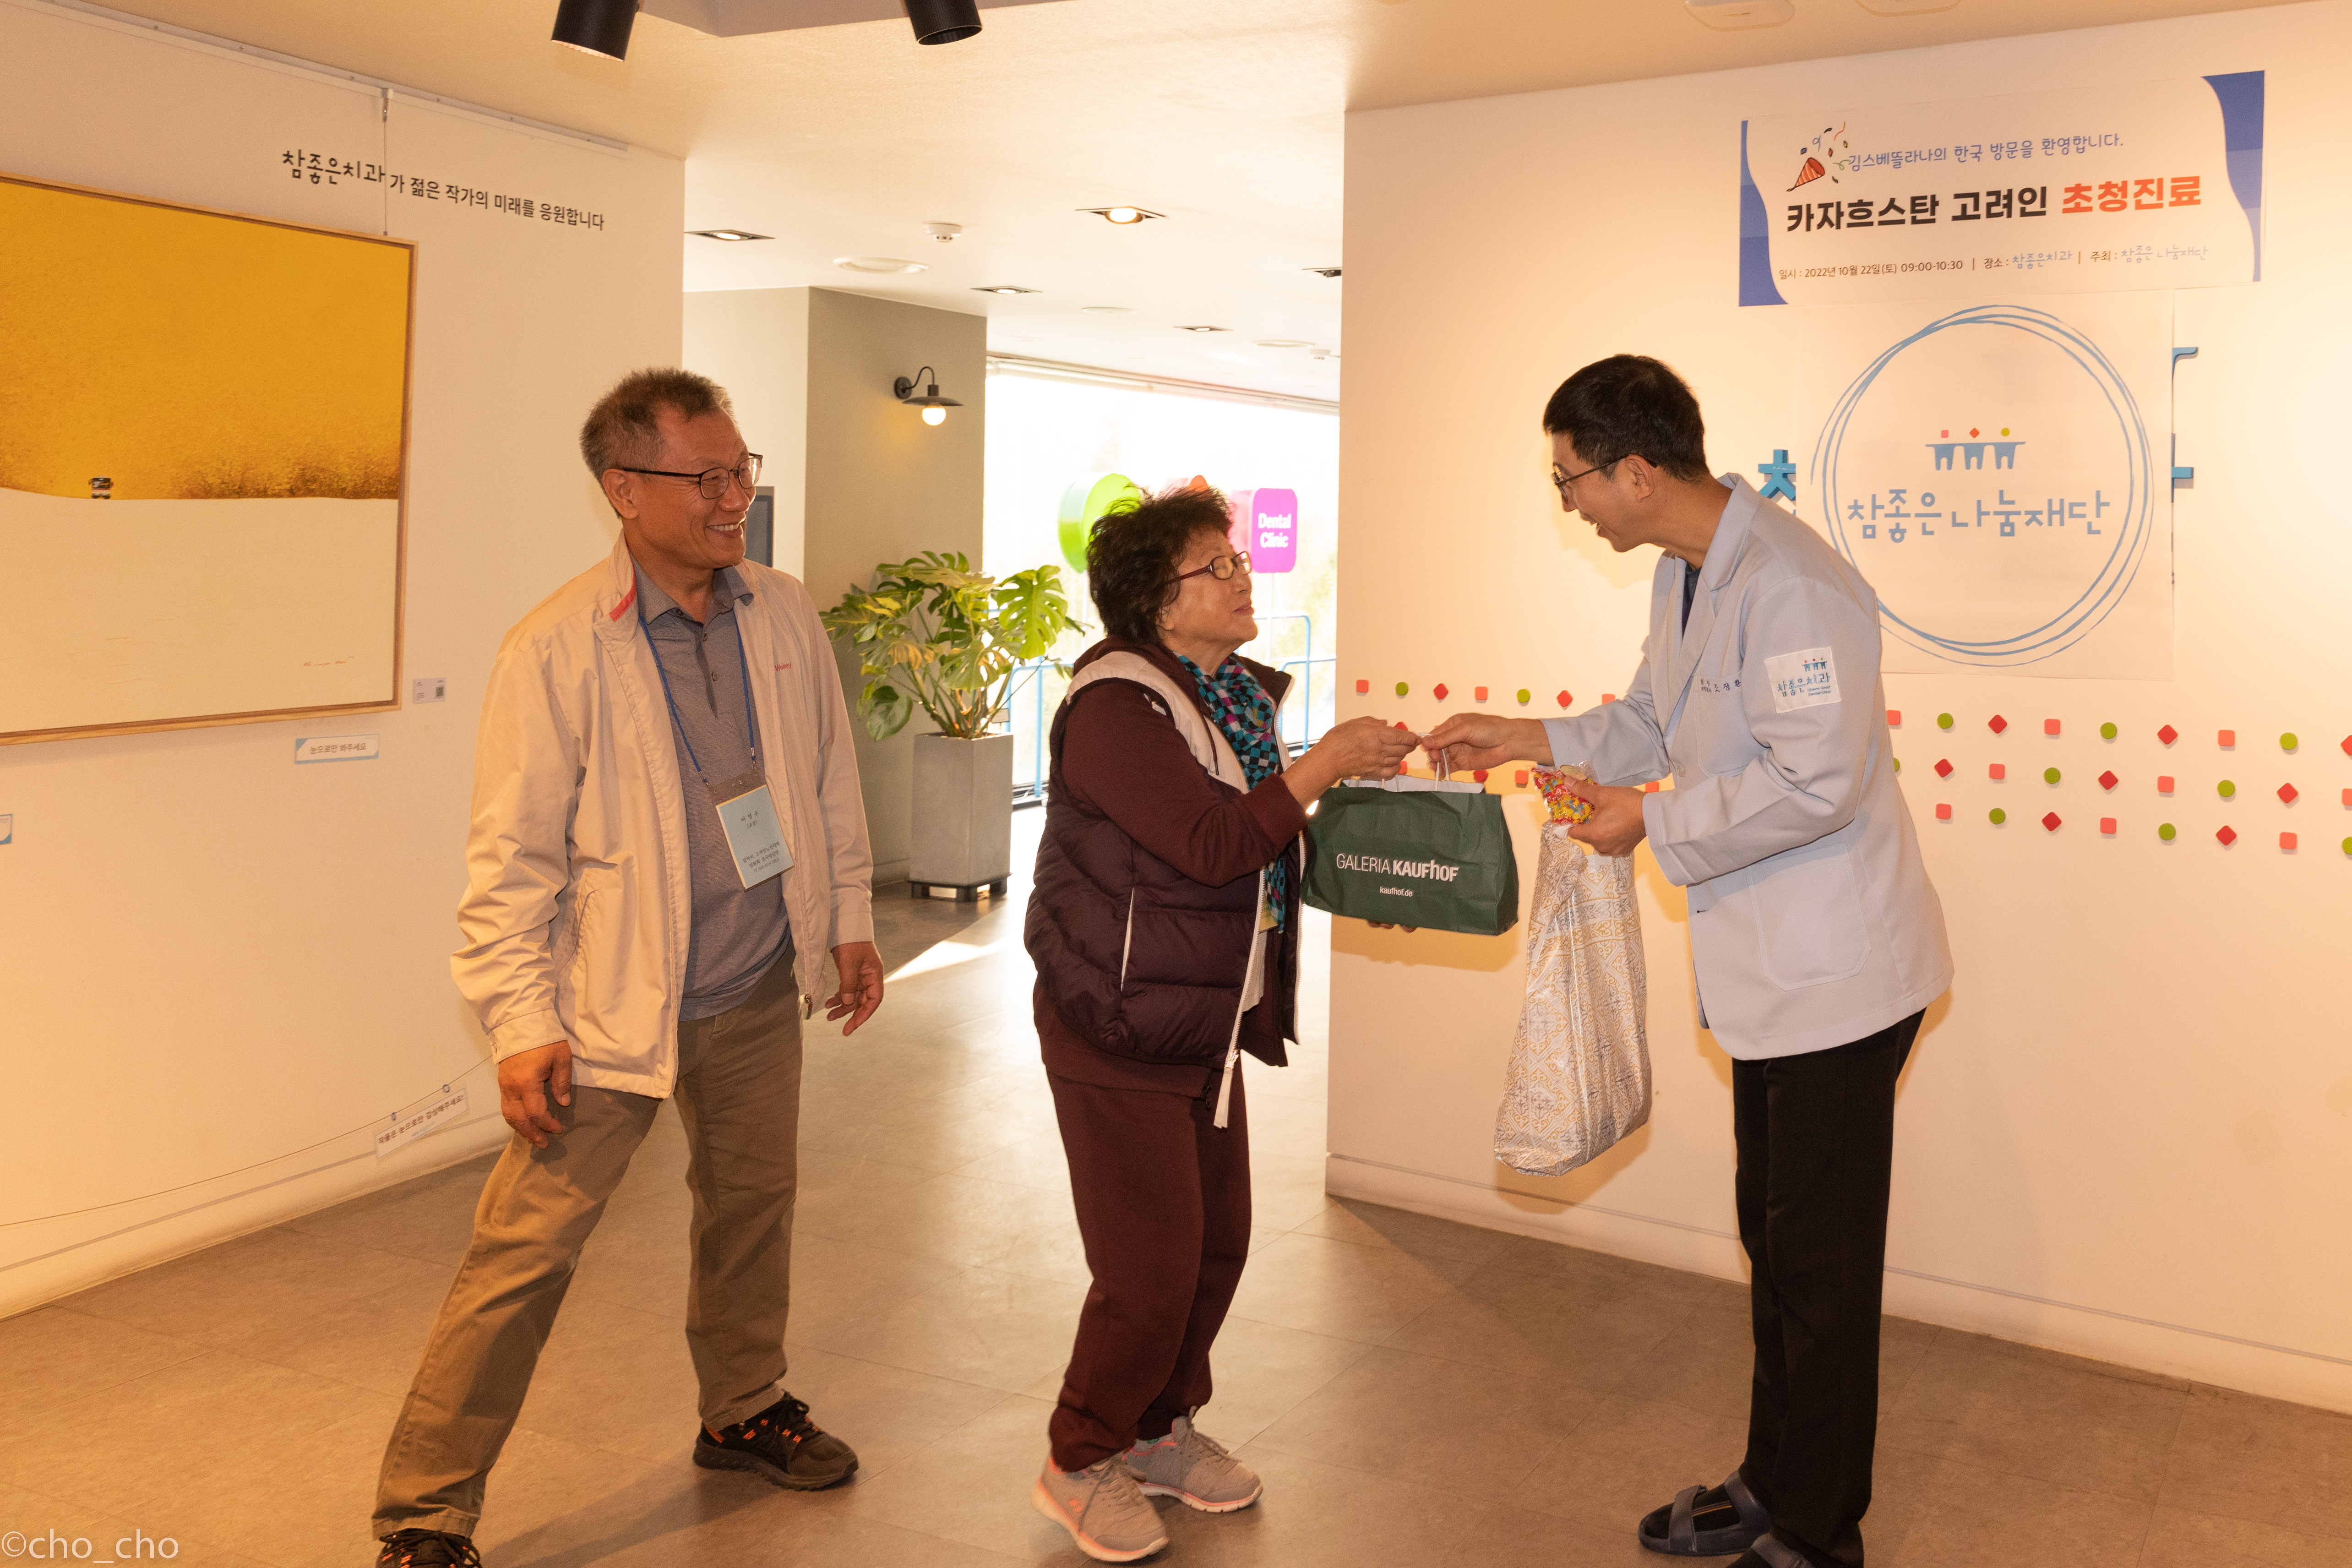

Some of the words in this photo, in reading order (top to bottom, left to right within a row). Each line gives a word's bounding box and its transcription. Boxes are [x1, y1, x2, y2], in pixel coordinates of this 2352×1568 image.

[1848, 147, 1946, 172] 김스베뜰라나의
[1955, 144, 1982, 163] 한국
[1990, 139, 2033, 161] 방문을
[2041, 133, 2123, 156] 환영합니다.
[283, 149, 386, 185] 참좋은치과
[390, 174, 404, 193] 가
[410, 178, 440, 200] 젊은
[445, 184, 488, 209] 작가의
[494, 195, 534, 218] 미래를
[539, 203, 604, 231] 응원합니다
[1787, 194, 1939, 232] 카자흐스탄
[1951, 185, 2047, 222] 고려인
[2062, 175, 2201, 214] 초청진료
[1779, 269, 1796, 280] 일시
[1805, 267, 1836, 278] 2022년
[1839, 265, 1857, 276] 10월
[1861, 263, 1897, 275] 22일(토)
[1901, 260, 1963, 272] 09:00-10:30
[1983, 257, 2003, 269] 장소
[2012, 250, 2073, 269] 참좋은치과
[2090, 251, 2111, 262] 주최
[2121, 245, 2153, 263] 참좋은
[2157, 244, 2209, 261] 나눔재단
[1258, 513, 1291, 528] Dental
[1847, 489, 1942, 543] 참좋은
[1952, 490, 2111, 537] 나눔재단
[1260, 532, 1289, 548] Clinic
[774, 662, 791, 672] Wolsey
[1778, 672, 1830, 697] 참좋은치과
[310, 745, 338, 754] 눈으로만
[1336, 853, 1390, 874] GALERIA
[1380, 886, 1413, 897] kaufhof.de
[399, 1116, 424, 1134] 눈으로만
[426, 1094, 463, 1120] 감상해주세요
